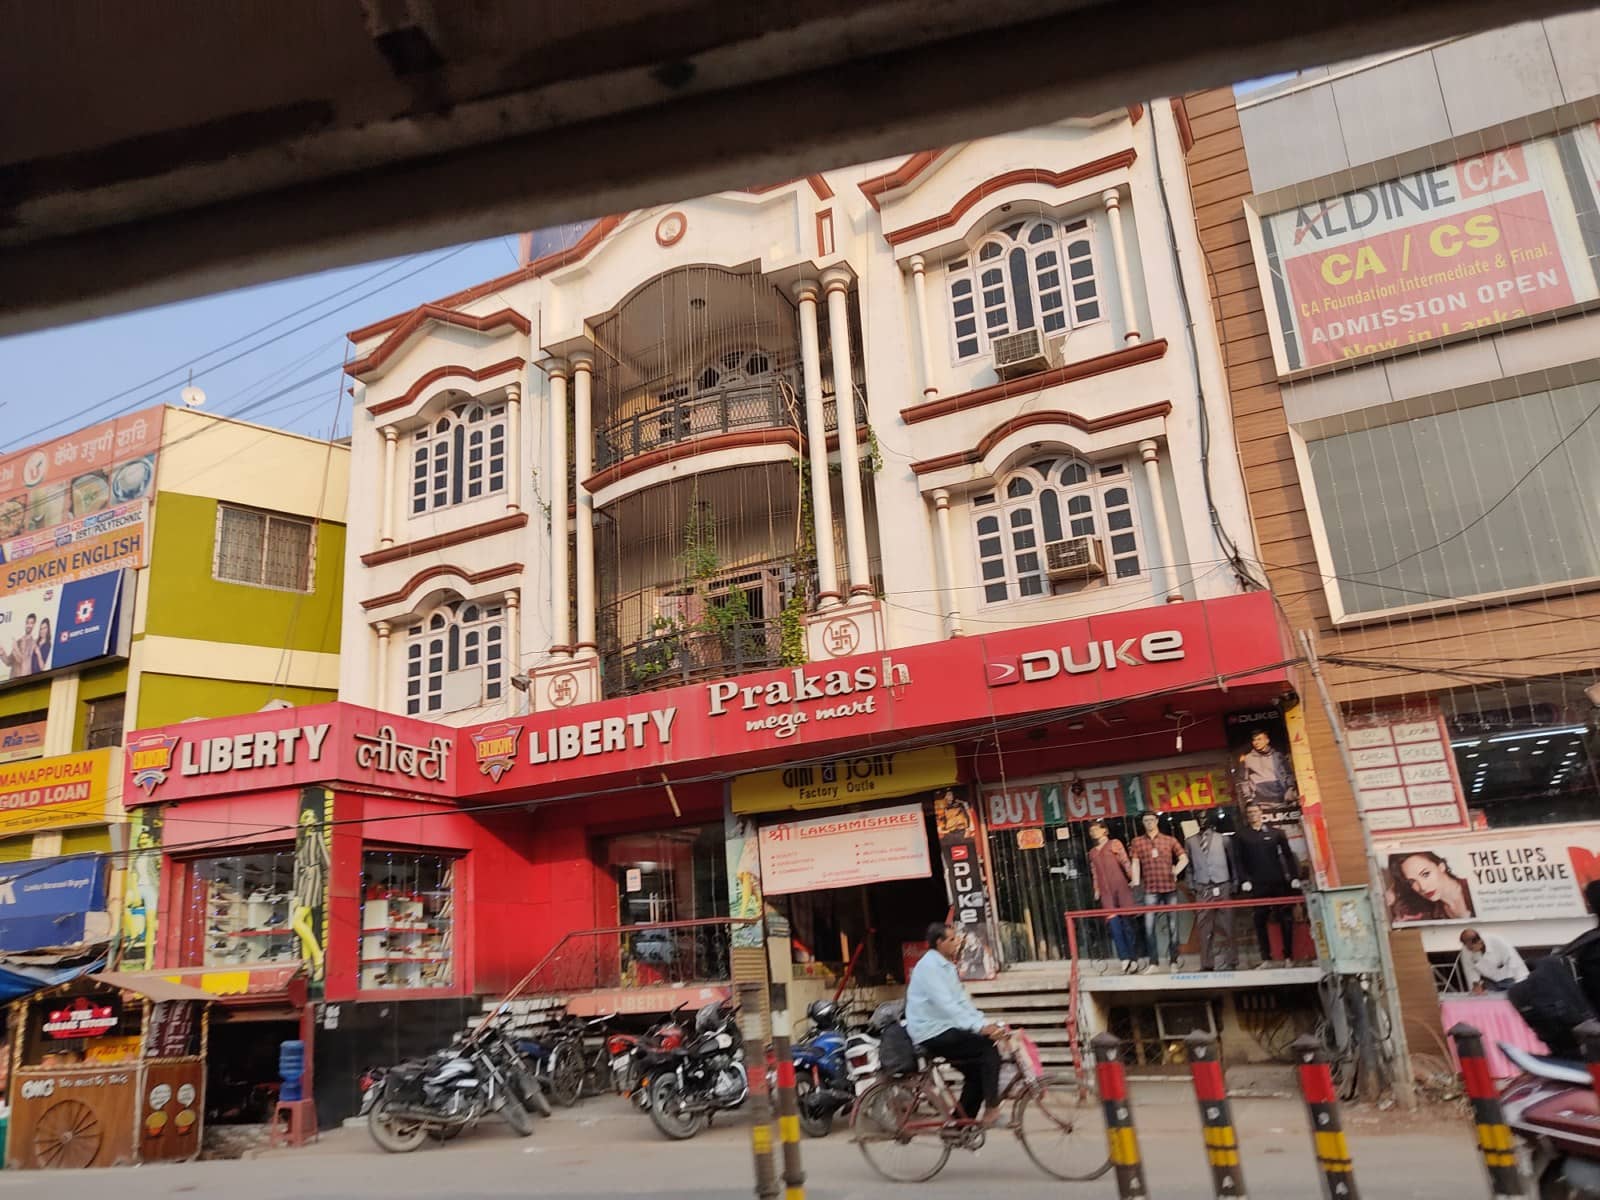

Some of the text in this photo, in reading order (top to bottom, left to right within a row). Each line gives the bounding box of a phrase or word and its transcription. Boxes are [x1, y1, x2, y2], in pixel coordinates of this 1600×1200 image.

[1293, 151, 1519, 246] ALDINE CA
[1321, 246, 1386, 286] CA
[1429, 214, 1500, 258] CS
[1301, 301, 1321, 318] CA
[1495, 253, 1508, 270] &
[1312, 268, 1560, 345] ADMISSION OPEN
[7, 556, 68, 589] SPOKEN
[72, 534, 141, 571] ENGLISH
[707, 656, 913, 717] Prakash
[529, 707, 678, 765] LIBERTY
[746, 695, 878, 739] mega mart
[0, 760, 93, 787] MANAPPURAM
[181, 723, 331, 776] LIBERTY
[45, 781, 89, 802] LOAN
[799, 783, 840, 801] Factory
[988, 769, 1233, 825] BUY 1 GET 1 FREE
[768, 823, 792, 842] श्री
[799, 812, 919, 837] LAKSHMISHREE
[1468, 847, 1547, 869] THE LIPS
[1473, 863, 1569, 886] YOU CRAVE
